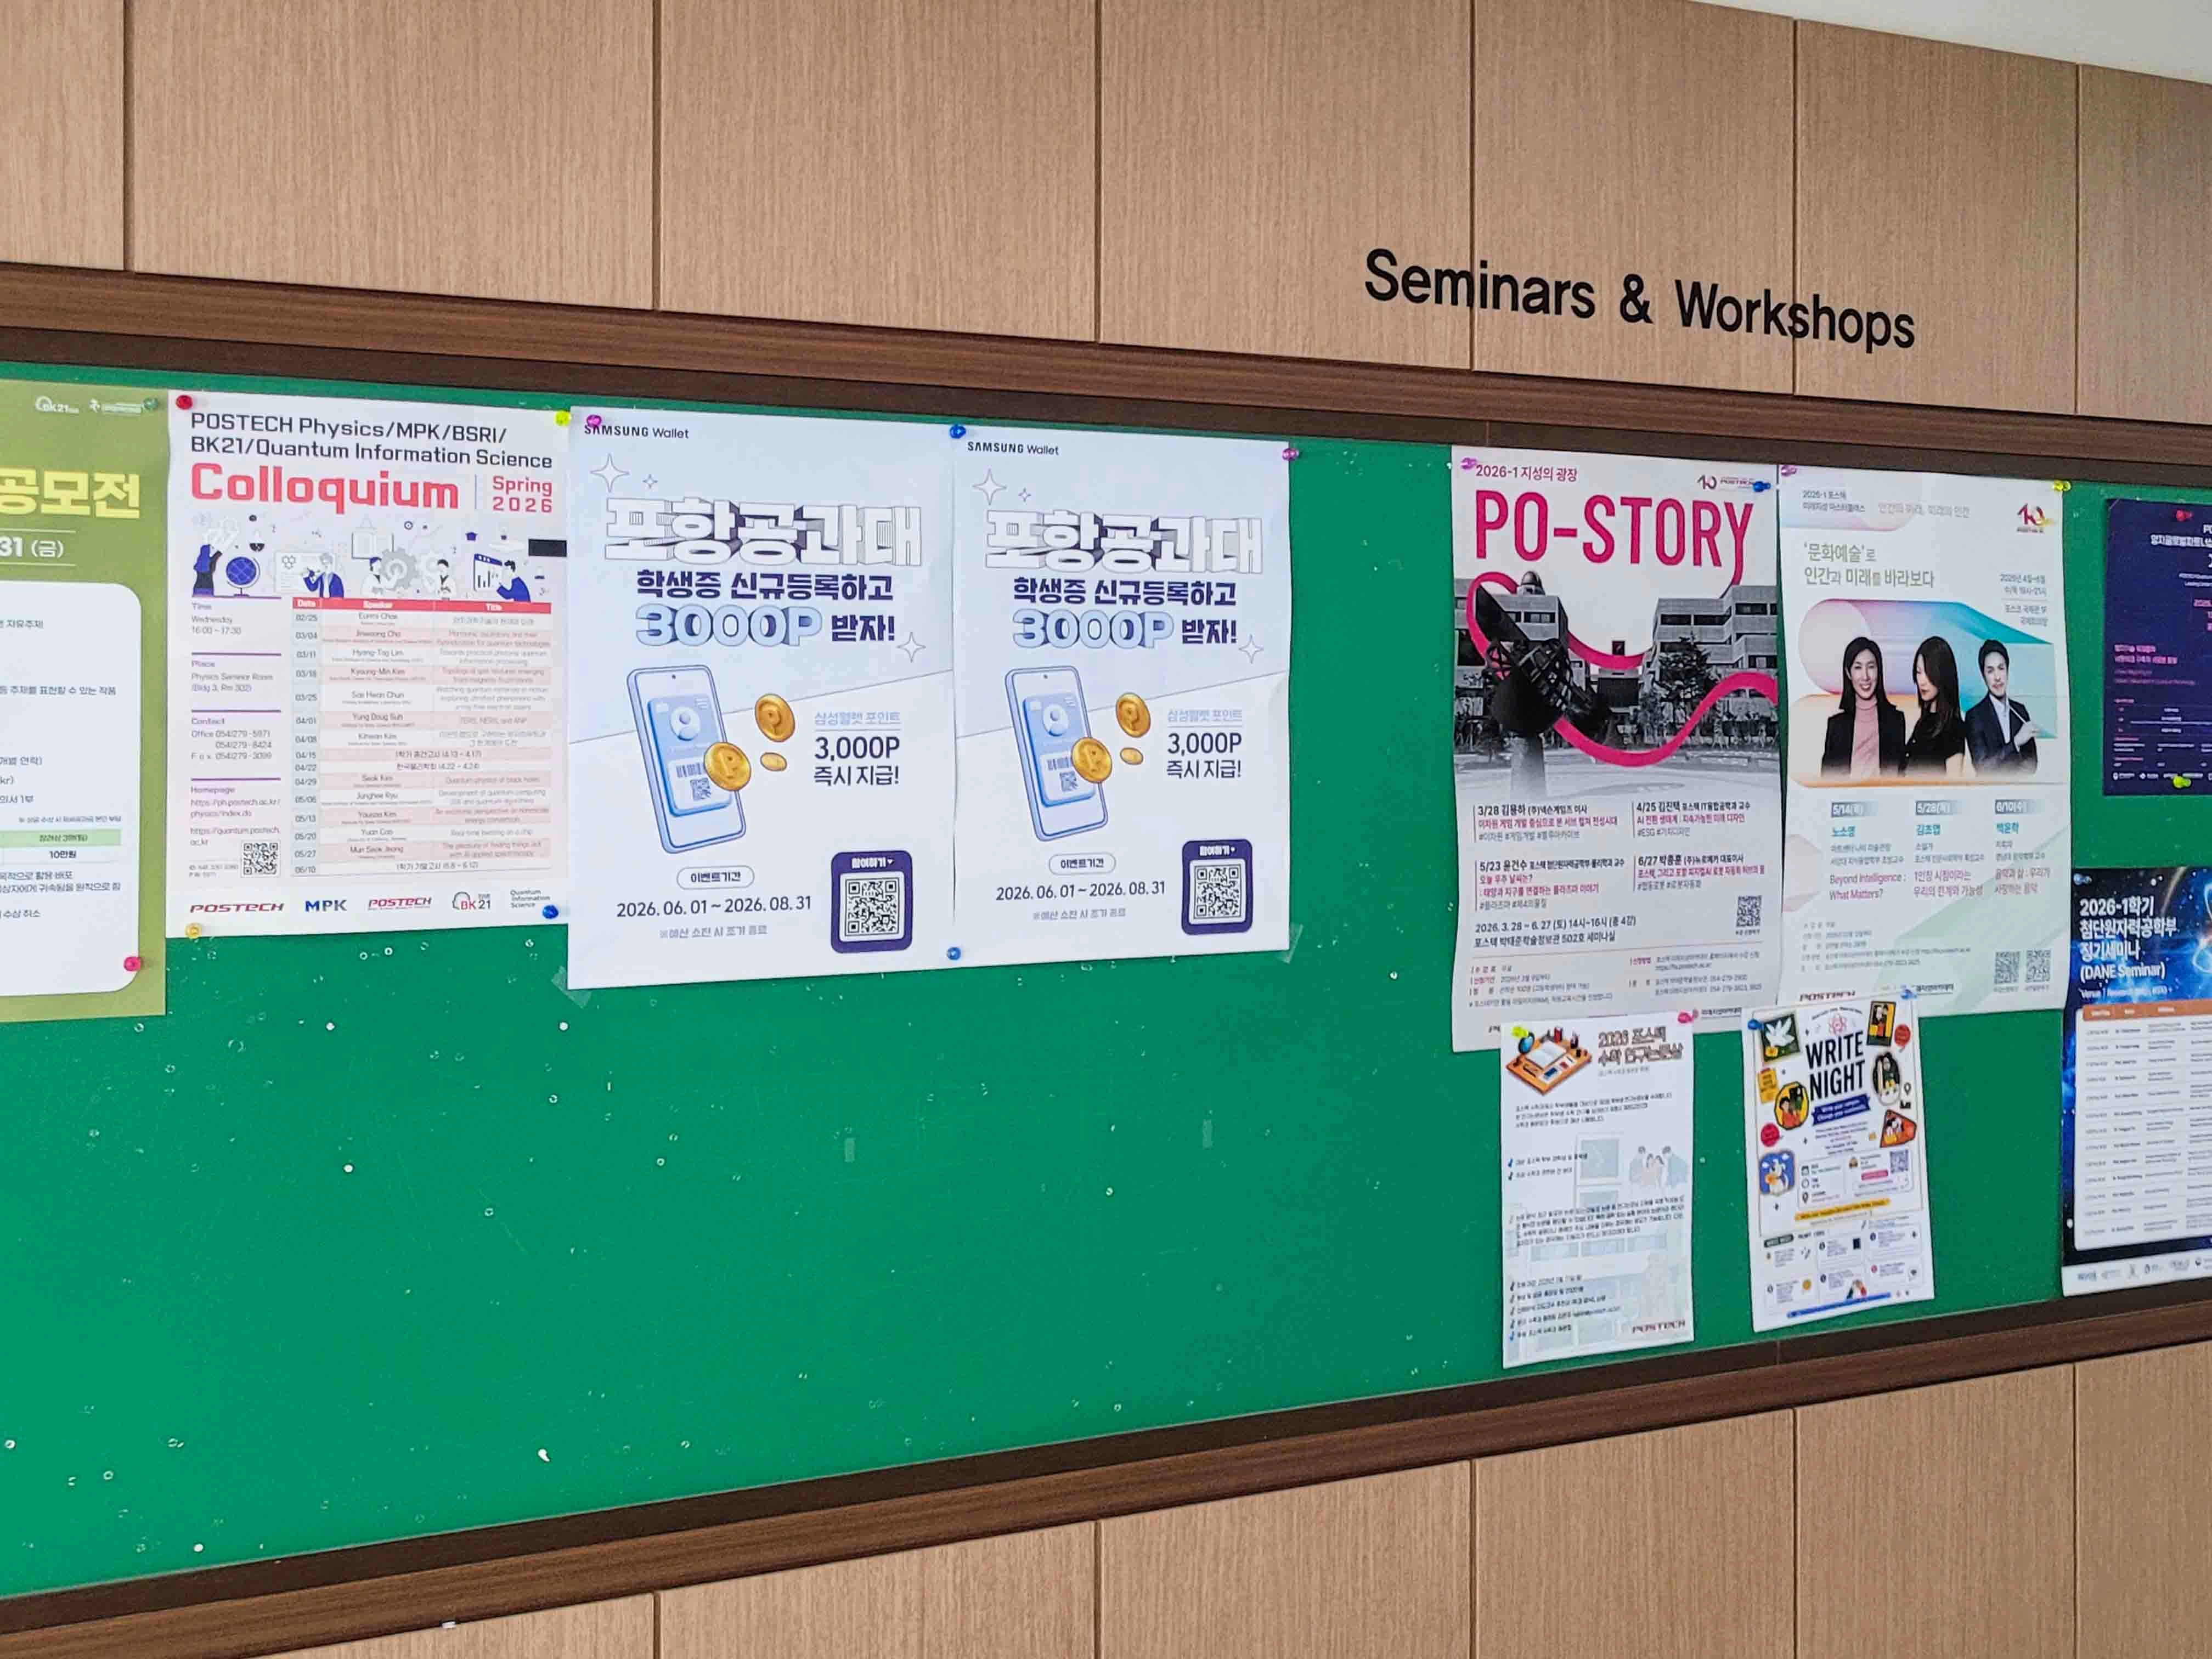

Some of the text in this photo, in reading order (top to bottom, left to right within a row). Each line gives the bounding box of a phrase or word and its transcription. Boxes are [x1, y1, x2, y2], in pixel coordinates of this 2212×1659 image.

[1364, 249, 1915, 353] Seminars & Workshops
[191, 413, 507, 444] POSTECH Physics/MPK/BSRI/
[584, 425, 690, 439] SAMSUNG Wallet
[191, 436, 553, 469] BK21/Quantum Information Science
[967, 441, 1059, 456] SAMSUNG Wallet
[1475, 465, 1578, 482] 2026-1 지성의 광장
[0, 467, 140, 518] 공모전
[191, 462, 459, 515] Colloquium
[492, 475, 553, 496] Spring
[492, 496, 553, 514] 2026
[605, 496, 922, 567] 포항공과대
[1475, 489, 1754, 586] PO-STORY
[0, 536, 64, 558] 31 (금)
[985, 509, 1262, 574] 포항공과대
[636, 569, 893, 601] 학생증 신규등록하고
[1804, 567, 1935, 588] 인간과 미래를 바라보다
[1013, 576, 1237, 606] 학생증 신규등록하고
[6, 620, 43, 629] 자유주제
[191, 616, 233, 624] Wednesday
[635, 603, 895, 647] 3000P 받자!
[1012, 608, 1237, 649] 3000P 받자!
[191, 673, 219, 681] Physics
[69, 686, 77, 695] 수
[79, 686, 97, 695] 있는
[99, 686, 116, 695] 작품
[814, 711, 901, 726] 삼성월렛 포인트
[1211, 709, 1243, 722] 포인트
[191, 730, 214, 738] Office
[814, 736, 901, 762] 3,000P
[1167, 732, 1243, 757] 3,000P
[813, 765, 900, 786] 즉시 지급!
[1166, 759, 1242, 780] 즉시 지급!
[190, 786, 235, 794] Homepage
[1477, 805, 1499, 816] 3/28
[1637, 801, 1656, 812] 4/25
[50, 850, 77, 859] 10만원
[1638, 855, 1658, 867] 6/27
[1060, 858, 1104, 870] 이벤트기간
[1480, 861, 1501, 872] 5/23
[690, 871, 741, 883] 이벤트기간
[1830, 872, 1902, 887] Beyond Intelligence
[1829, 888, 1883, 900] What Matters?
[190, 903, 285, 913] POSTECH
[305, 899, 347, 912] MPK
[368, 897, 432, 909] POSTECH
[2079, 895, 2155, 917] 2026-1학기
[1080, 908, 1088, 919] 시
[691, 928, 712, 938] 소진
[713, 927, 724, 937] 시
[726, 926, 746, 936] 조기
[1474, 937, 1497, 948] 포스텍
[1562, 933, 1585, 943] 502호
[1587, 931, 1616, 943] 세미나실
[2079, 939, 2141, 963] 정기세미나
[2080, 961, 2166, 984] (DANE Seminar)
[1805, 1030, 1864, 1070] WRITE
[1809, 1059, 1866, 1102] NIGHT
